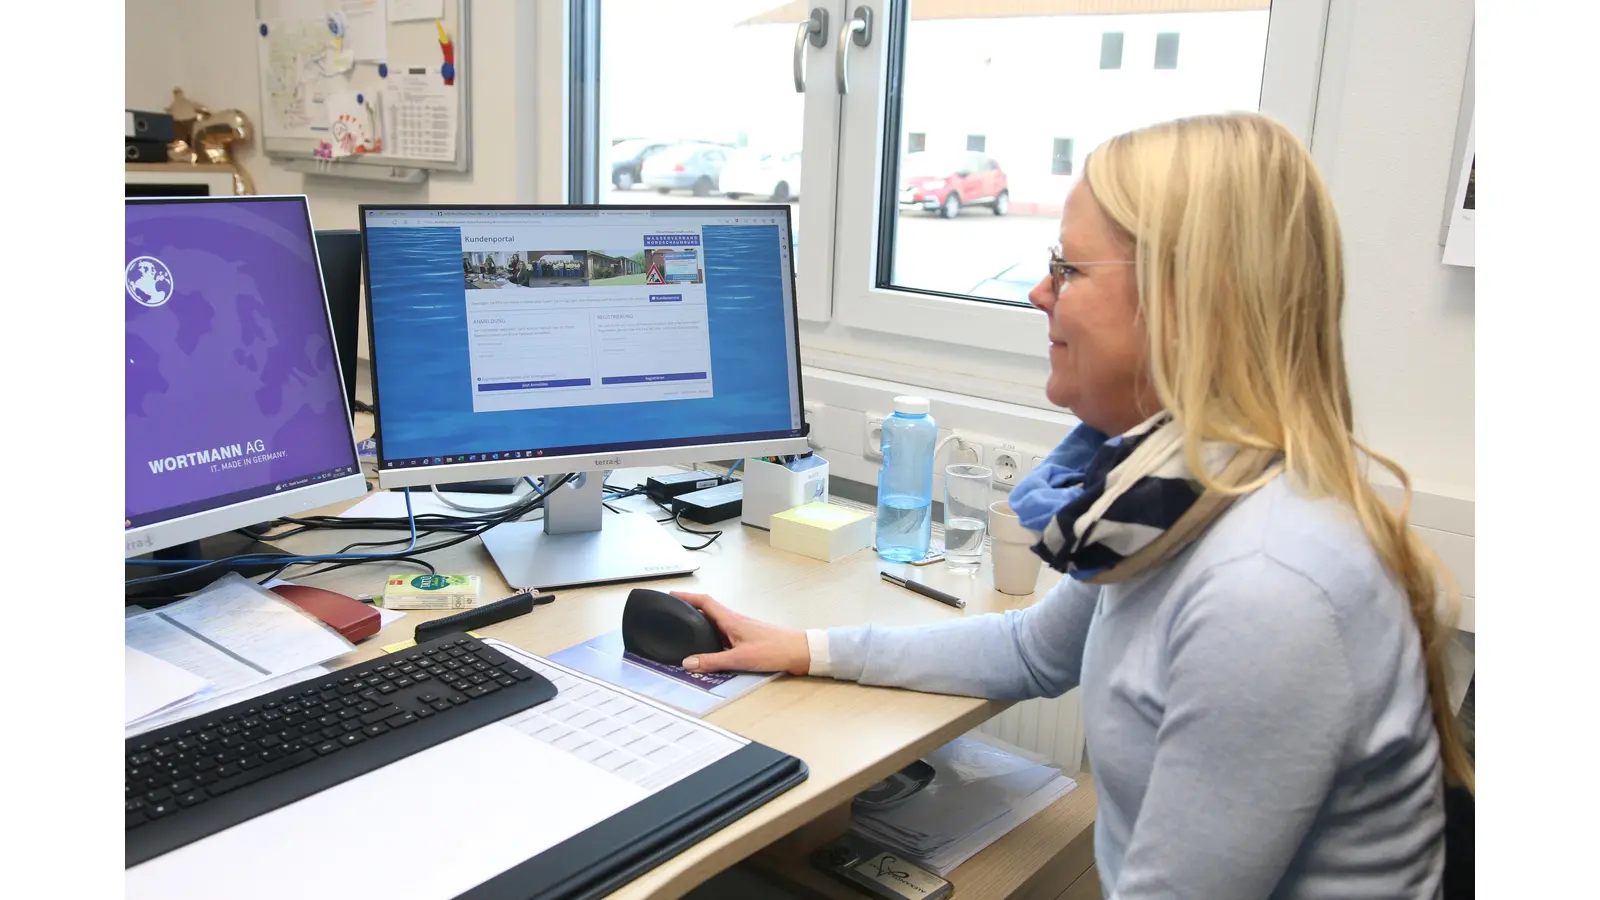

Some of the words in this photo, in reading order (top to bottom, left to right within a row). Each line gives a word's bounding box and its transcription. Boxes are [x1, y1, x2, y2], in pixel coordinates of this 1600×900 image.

[464, 235, 515, 244] Kundenportal
[147, 443, 242, 475] WORTMANN
[245, 439, 265, 455] AG
[210, 463, 221, 473] IT.
[221, 458, 243, 472] MADE
[243, 456, 252, 466] IN
[252, 450, 289, 465] GERMANY.
[595, 458, 614, 466] terra
